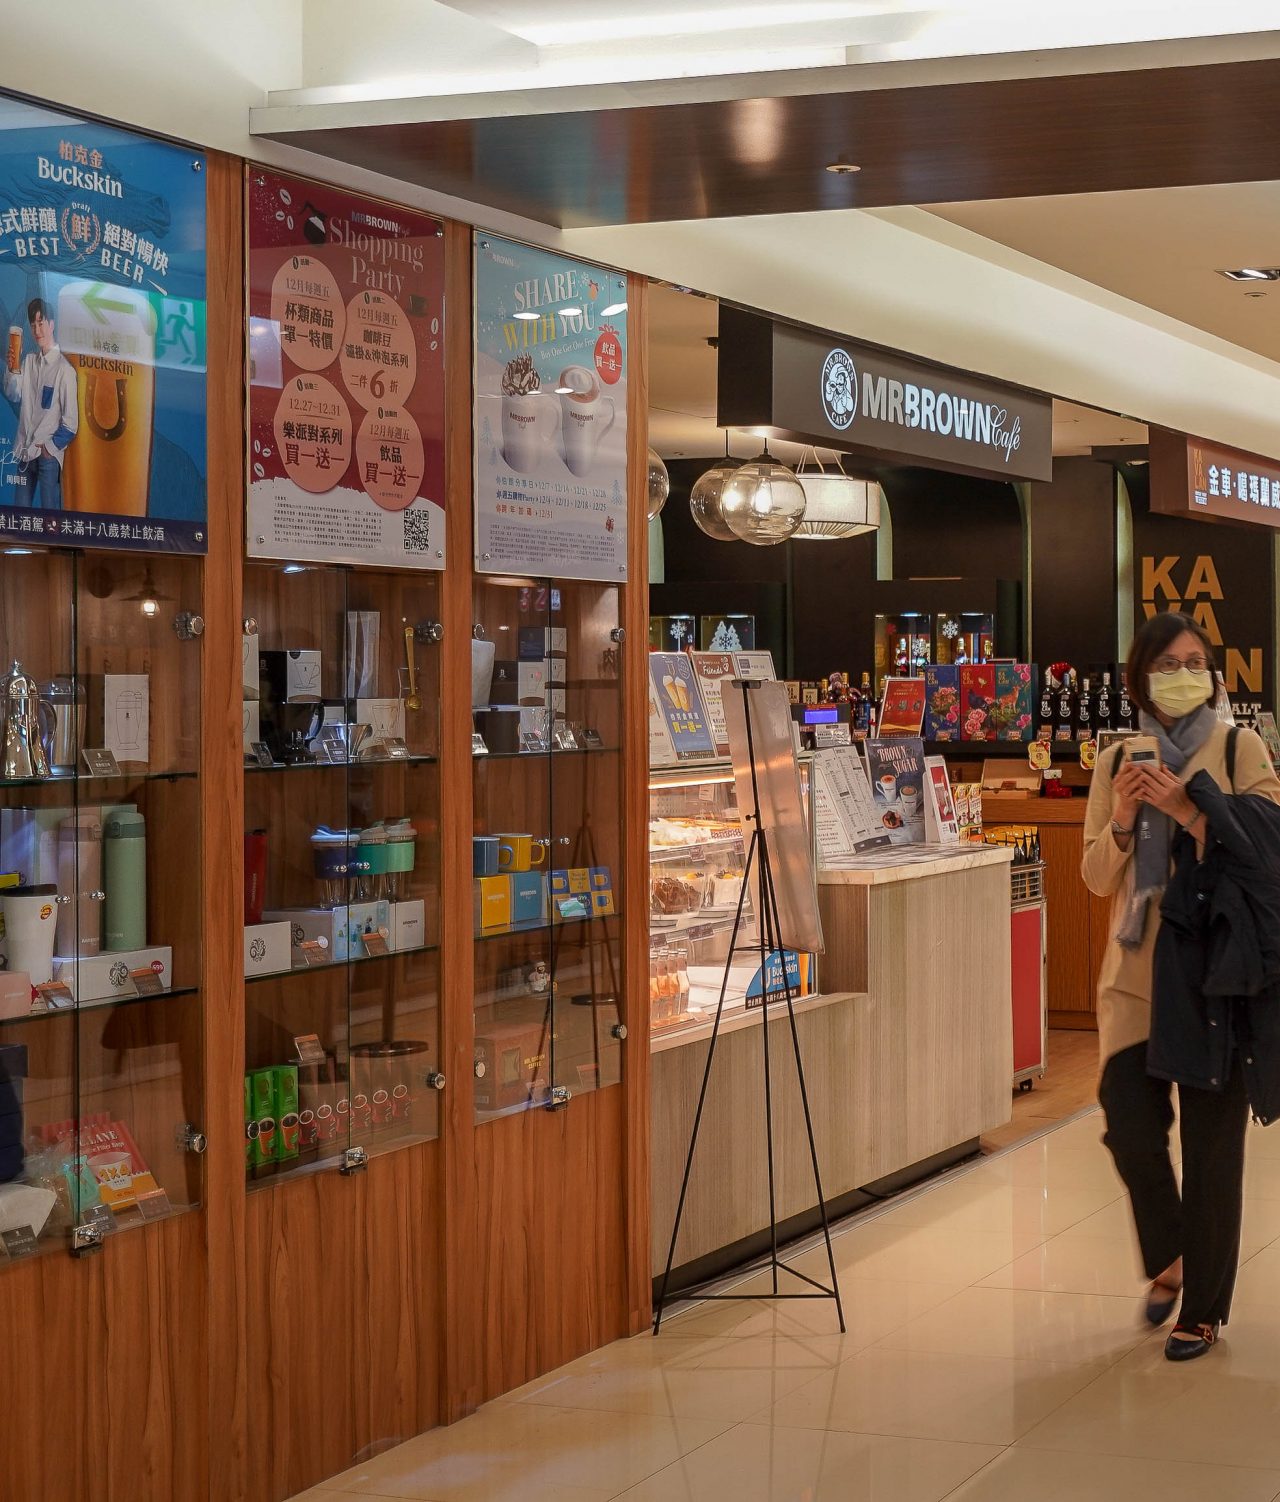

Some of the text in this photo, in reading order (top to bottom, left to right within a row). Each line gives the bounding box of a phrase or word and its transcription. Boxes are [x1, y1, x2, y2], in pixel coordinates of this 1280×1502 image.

[59, 139, 103, 169] 柏克金
[38, 157, 123, 199] Buckskin
[71, 201, 91, 213] Draft
[71, 213, 91, 243] 鮮
[15, 237, 60, 258] BEST
[103, 221, 169, 276] 絕對暢快
[330, 217, 424, 274] Shopping
[101, 248, 144, 284] BEER
[351, 256, 405, 298] Party
[285, 277, 331, 298] 12月每週五
[514, 269, 579, 312] SHARE
[284, 301, 335, 329] 杯類商品
[357, 307, 399, 327] 12月每週五
[559, 302, 596, 338] YOU
[283, 325, 334, 351] 單一特價
[503, 311, 557, 352] WITH
[79, 354, 134, 377] Buckskin
[370, 369, 385, 399] 6
[282, 420, 344, 446] 樂派對系列
[369, 423, 411, 442] 12月每週五
[989, 404, 1022, 462] Café
[284, 442, 346, 470] 買一送一
[380, 444, 403, 465] 飲品
[364, 461, 421, 488] 買一送一
[61, 519, 165, 542] 未滿十八歲禁止飲酒
[1142, 555, 1224, 600] KA
[877, 745, 908, 762] BROWN
[893, 757, 919, 779] SUGAR
[772, 963, 798, 978] Bucskin
